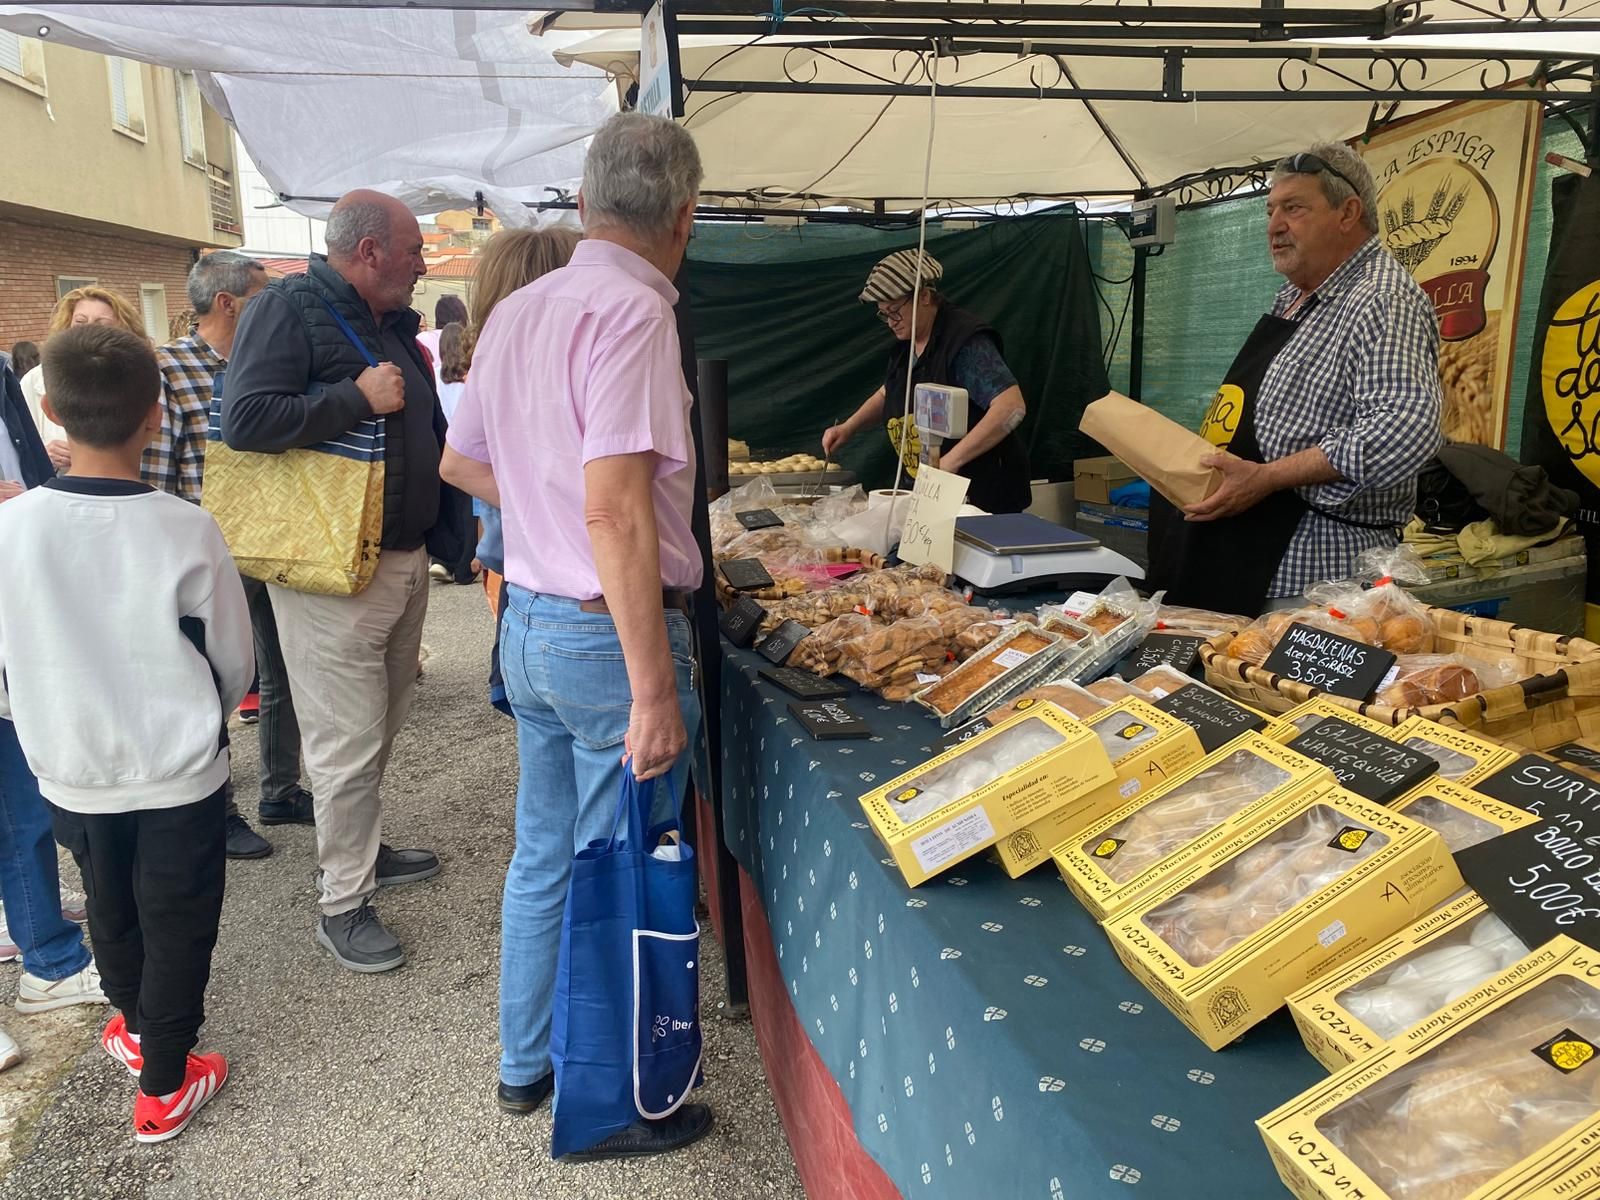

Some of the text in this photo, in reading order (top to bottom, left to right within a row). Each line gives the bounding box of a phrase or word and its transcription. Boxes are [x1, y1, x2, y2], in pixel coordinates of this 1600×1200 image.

[1407, 130, 1495, 171] ESPIGA
[1450, 254, 1478, 267] 1894
[1433, 281, 1474, 310] LLA
[1288, 628, 1367, 666] MAGDALENAS
[1287, 661, 1340, 693] 3,50€
[1252, 739, 1310, 771] ARTESANOS
[1314, 723, 1418, 770] GALLETAS
[1417, 724, 1492, 757] PRODUCTOS
[1002, 778, 1039, 801] Especialidad
[1276, 789, 1320, 818] Evergislo
[1436, 783, 1524, 824] ARTESANOS
[1327, 791, 1410, 835] PRODUCTOS
[1534, 826, 1594, 869] BOLLO
[1065, 850, 1112, 896] PRODUCTOS
[1116, 872, 1159, 901] Evergislo
[1508, 863, 1600, 925] 5,00€
[1121, 923, 1186, 981] ARTESANOS
[1497, 950, 1557, 988] Evergislo
[1408, 1013, 1453, 1041] Martín
[1376, 1063, 1389, 1075] LA
[1303, 1091, 1343, 1117] Salamanca
